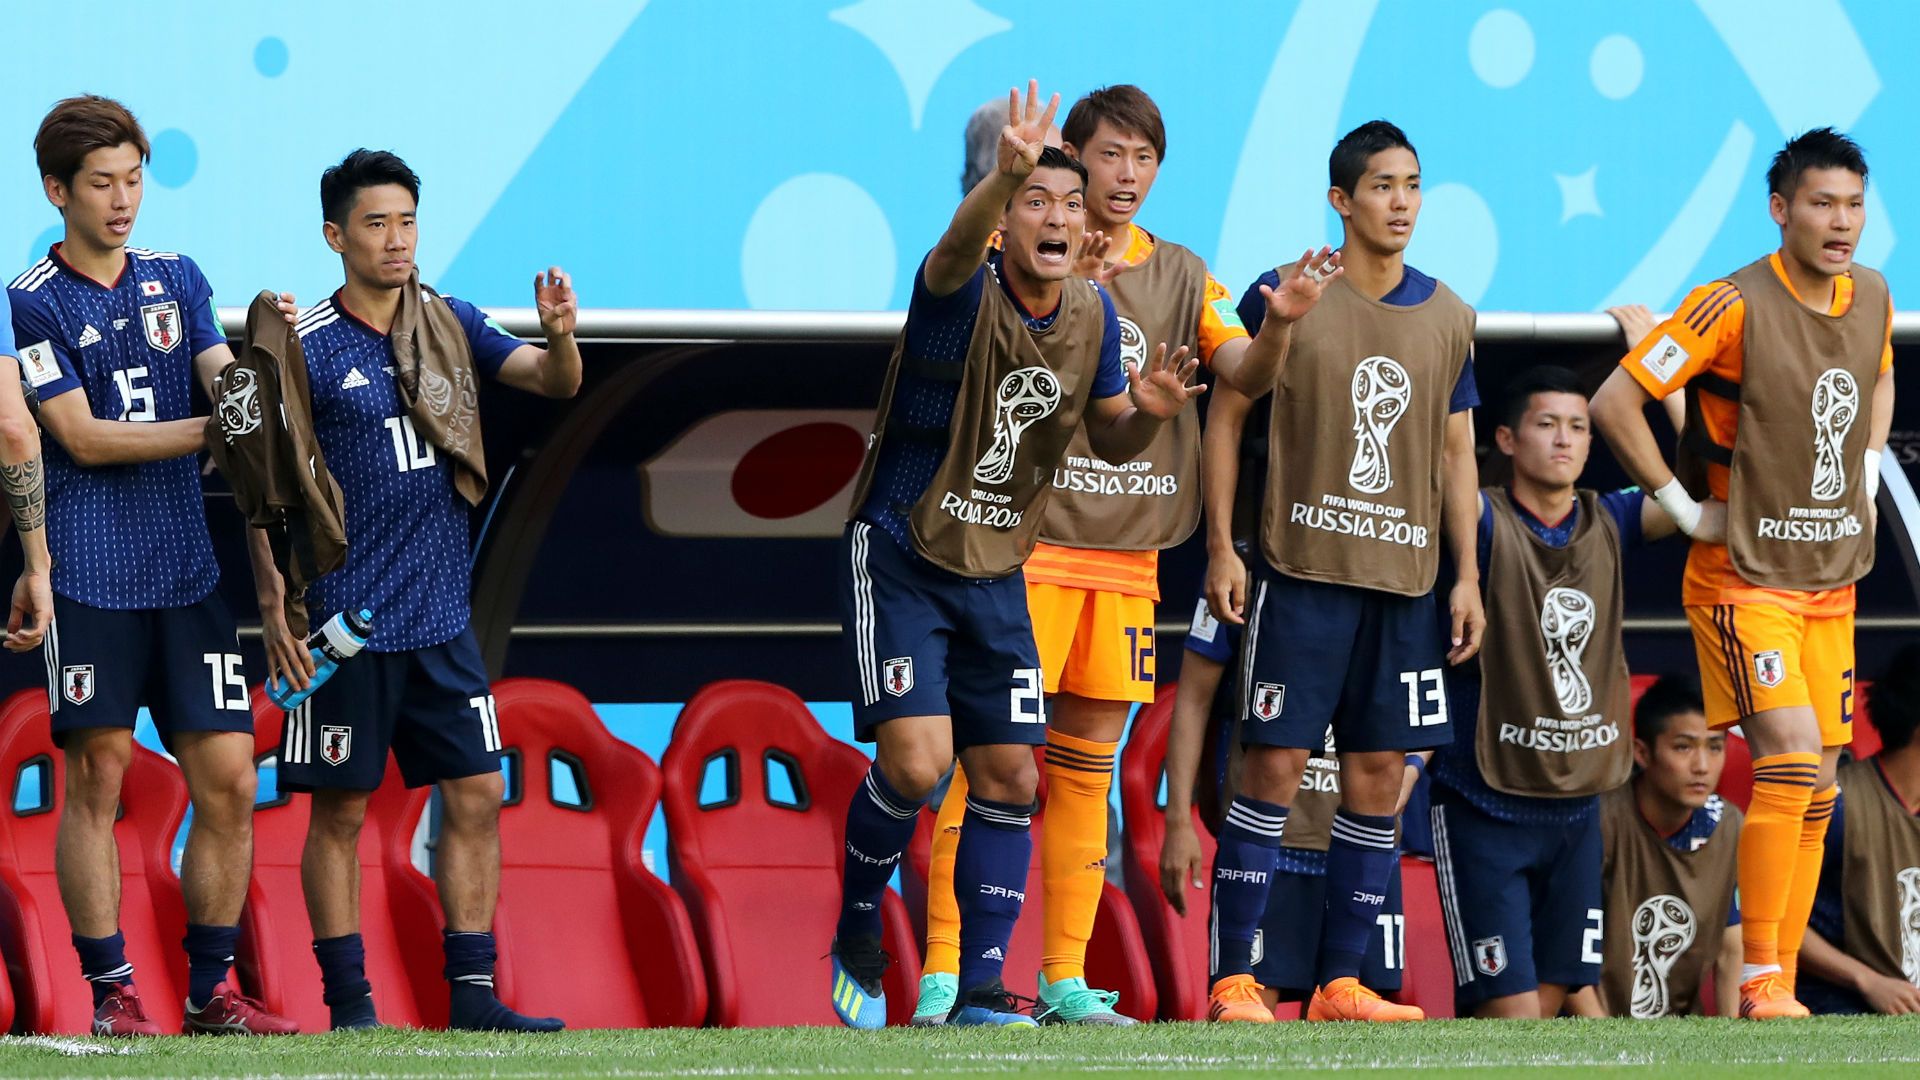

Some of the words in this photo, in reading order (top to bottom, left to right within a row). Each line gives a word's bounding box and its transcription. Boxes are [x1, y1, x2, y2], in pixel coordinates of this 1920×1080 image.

[113, 366, 157, 422] 15
[384, 415, 436, 473] 10
[1067, 456, 1091, 469] FIFA
[1128, 461, 1152, 472] CUP
[971, 488, 995, 502] ORLD
[994, 494, 1012, 505] CUP
[1126, 474, 1178, 496] 2018
[1322, 494, 1347, 509] FIFA
[1347, 498, 1385, 515] WORLD
[1384, 505, 1406, 519] CUP
[1788, 506, 1809, 518] FIFA
[1809, 507, 1839, 519] WORLD
[1290, 502, 1377, 539] RUSSIA
[1378, 519, 1428, 548] 2018
[1757, 517, 1832, 542] RUSSIA
[1125, 627, 1153, 682] 12
[203, 652, 250, 710] 15
[1010, 667, 1047, 724] 21
[1400, 667, 1448, 727] 13
[846, 840, 902, 867] JAPAN
[1216, 867, 1267, 884] JAPAN
[980, 884, 1025, 904] JAPA
[1376, 913, 1405, 970] 11
[1581, 908, 1604, 964] 2
